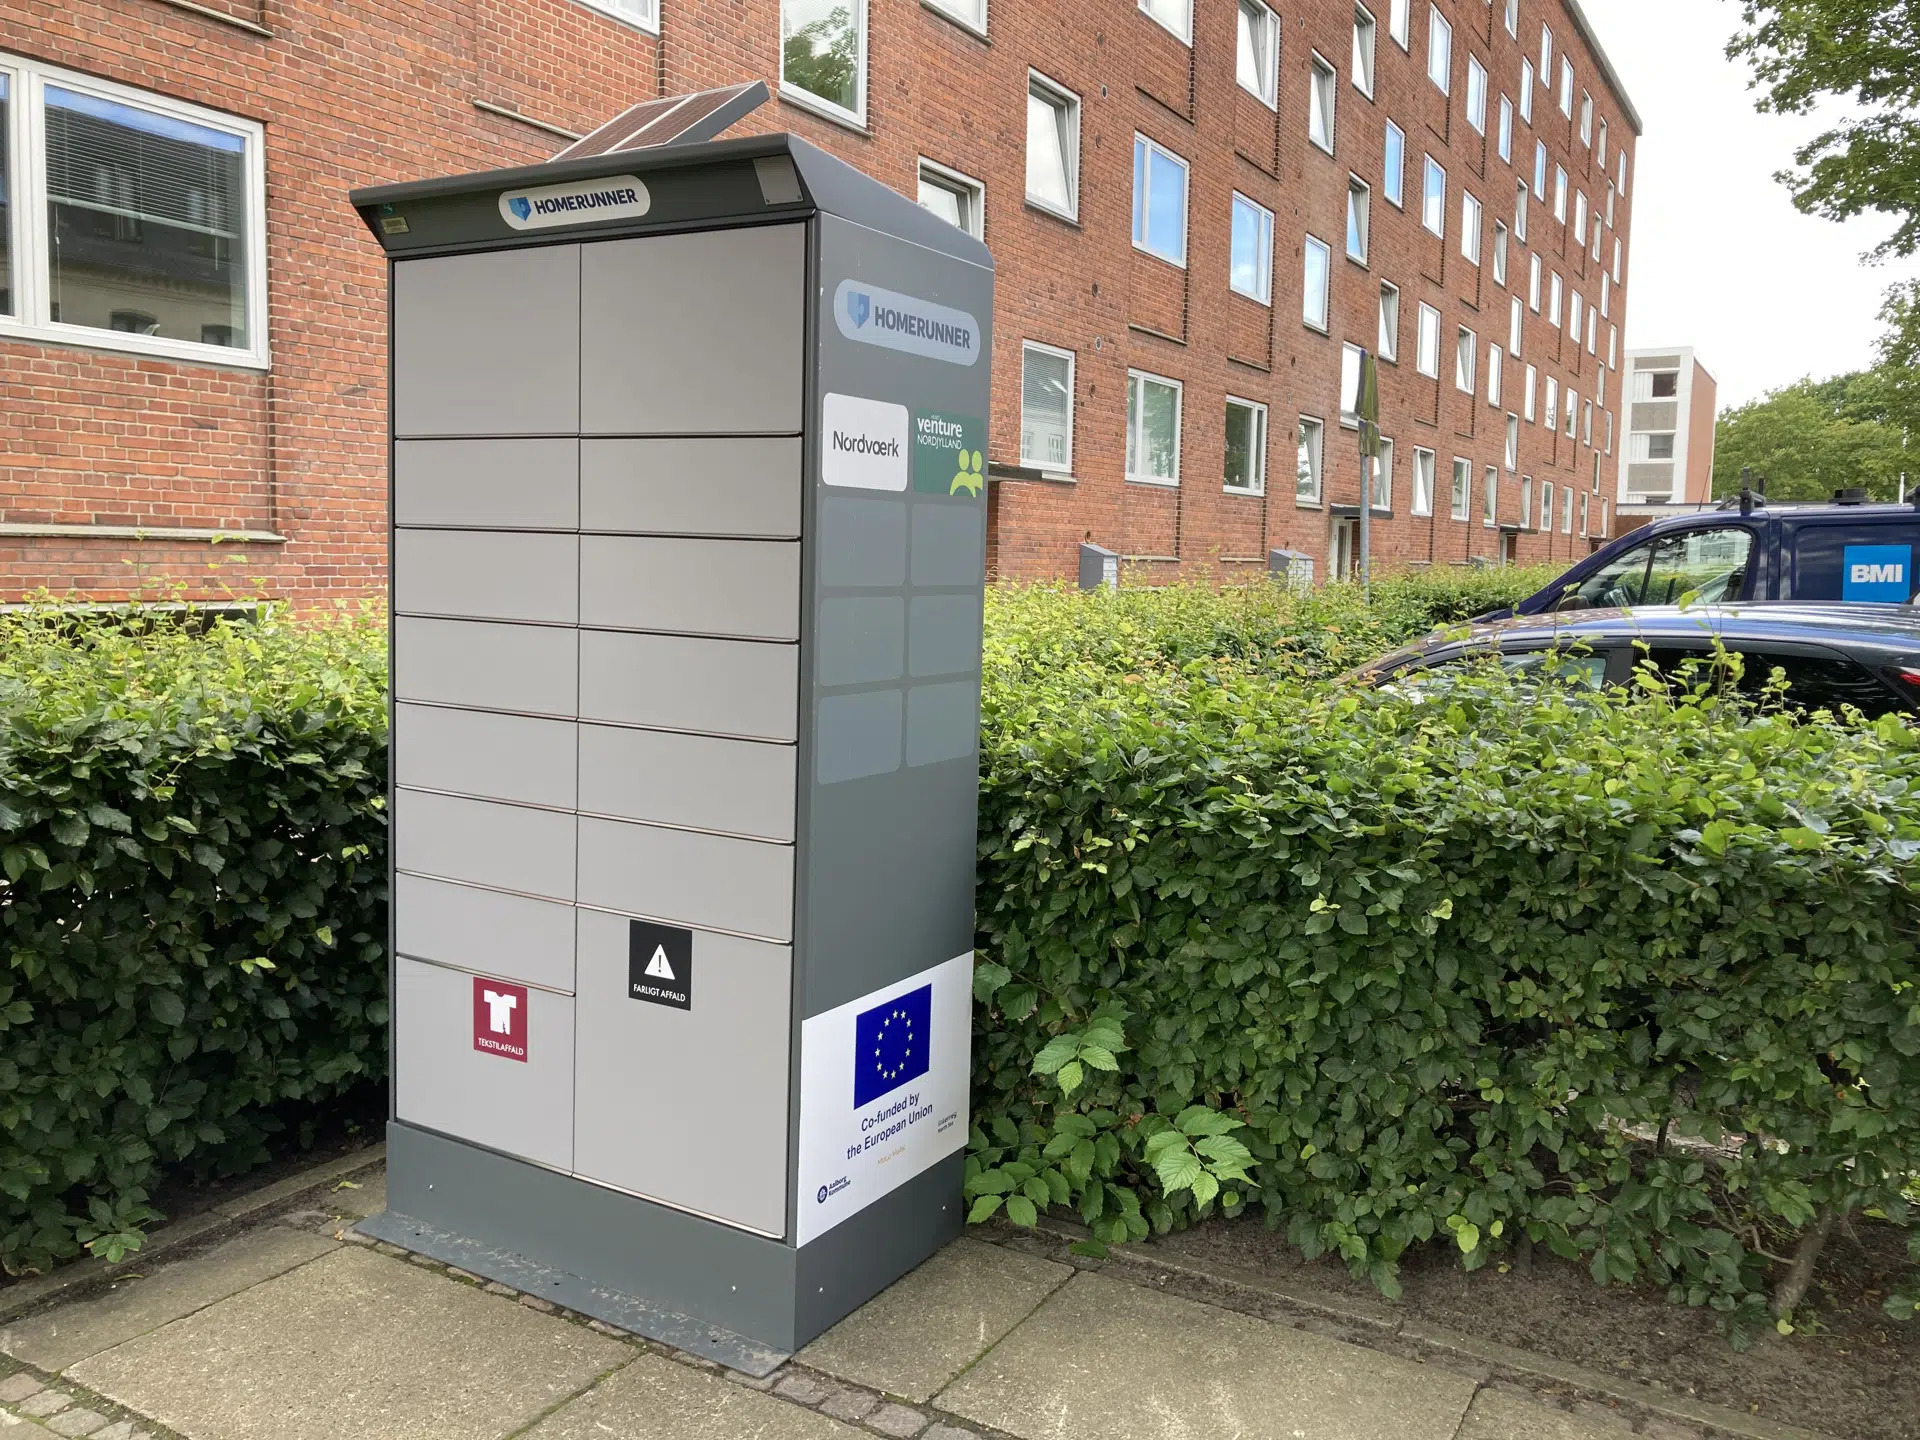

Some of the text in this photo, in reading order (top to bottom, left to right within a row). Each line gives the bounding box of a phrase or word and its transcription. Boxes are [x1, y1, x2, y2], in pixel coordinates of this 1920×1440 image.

[534, 188, 639, 215] HOMERUNNER
[874, 306, 971, 349] HOMERUNNER
[917, 417, 963, 438] venture
[1851, 564, 1903, 583] BMI
[633, 983, 686, 1002] FARLIGT AFFALD
[478, 1037, 524, 1056] TEKSTILAFFALD
[861, 1092, 920, 1132] Co-funded by
[847, 1104, 933, 1160] the European Union
